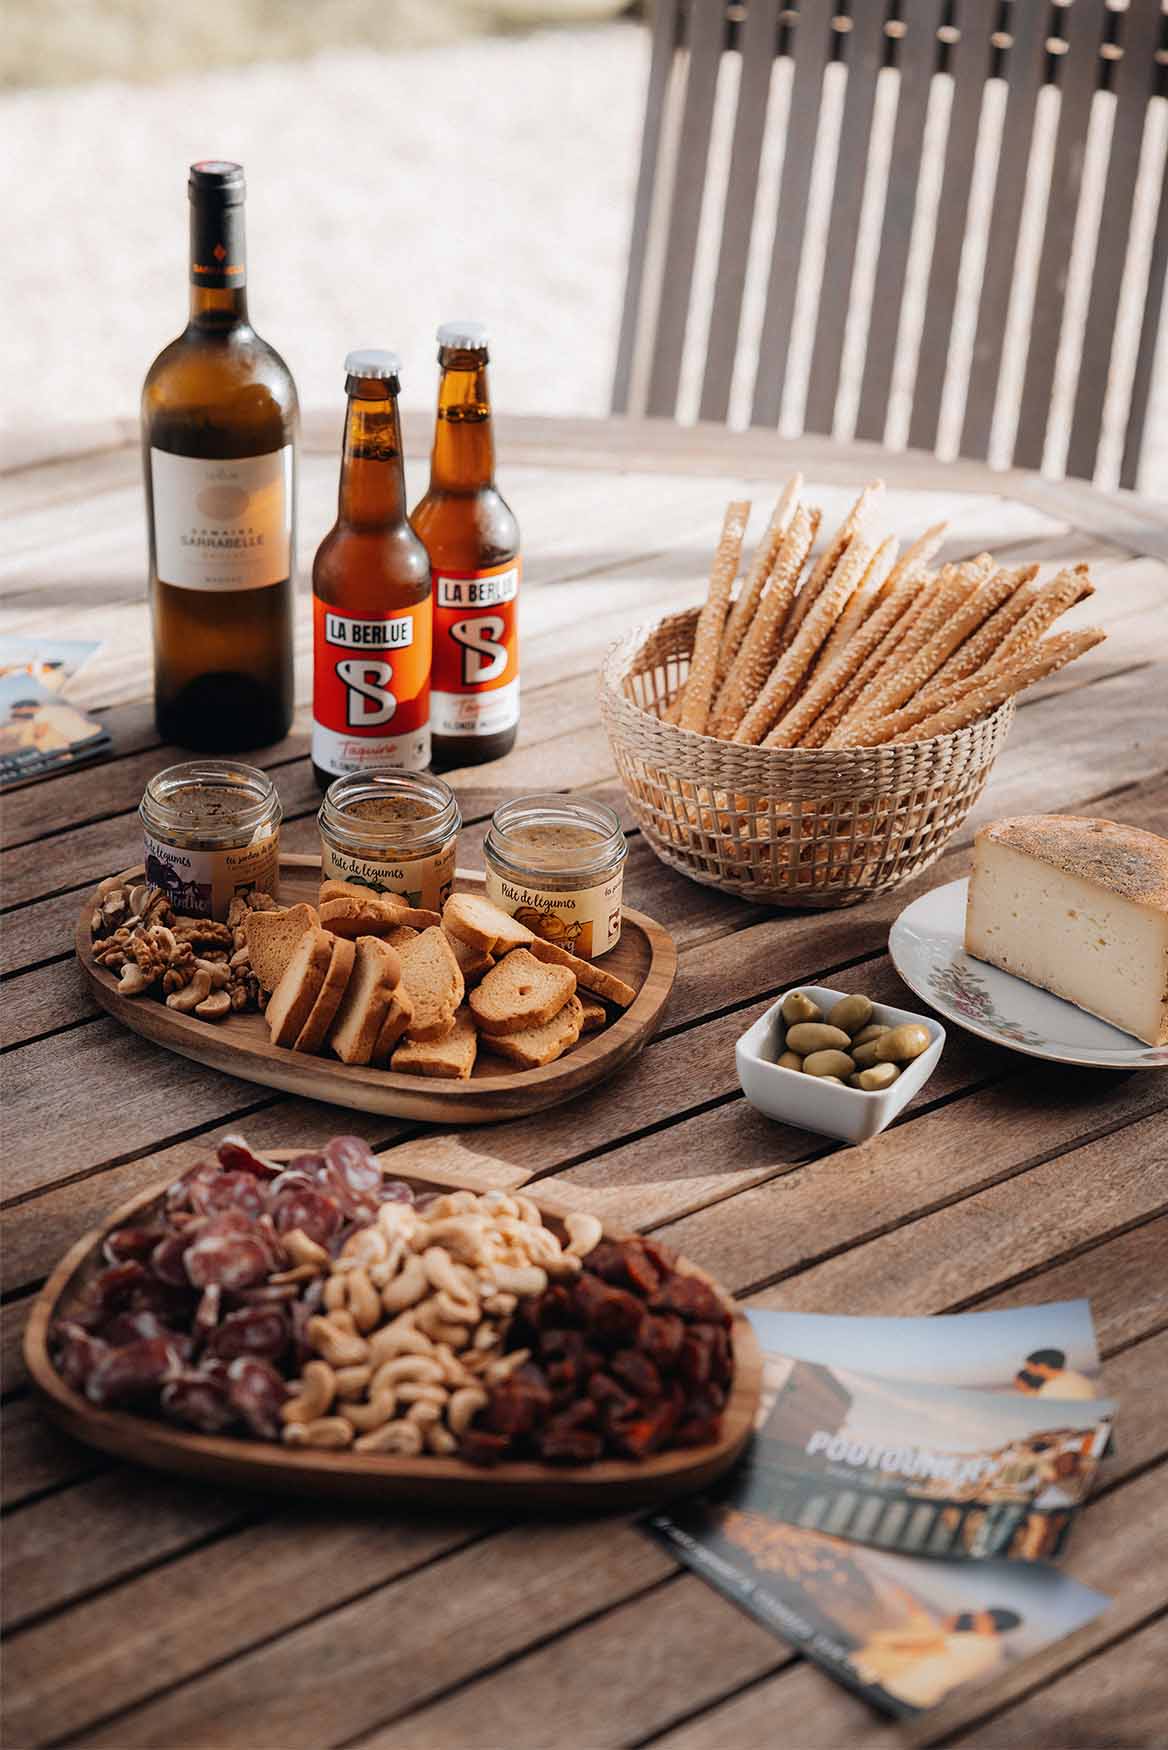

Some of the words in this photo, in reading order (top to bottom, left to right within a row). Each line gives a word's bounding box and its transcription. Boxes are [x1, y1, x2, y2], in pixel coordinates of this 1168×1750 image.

[445, 583, 463, 602] LA
[331, 620, 347, 642] LA
[352, 622, 407, 644] BERLUE
[349, 860, 362, 876] de
[362, 863, 405, 882] légumes
[520, 889, 534, 906] de
[534, 893, 577, 914] légumes
